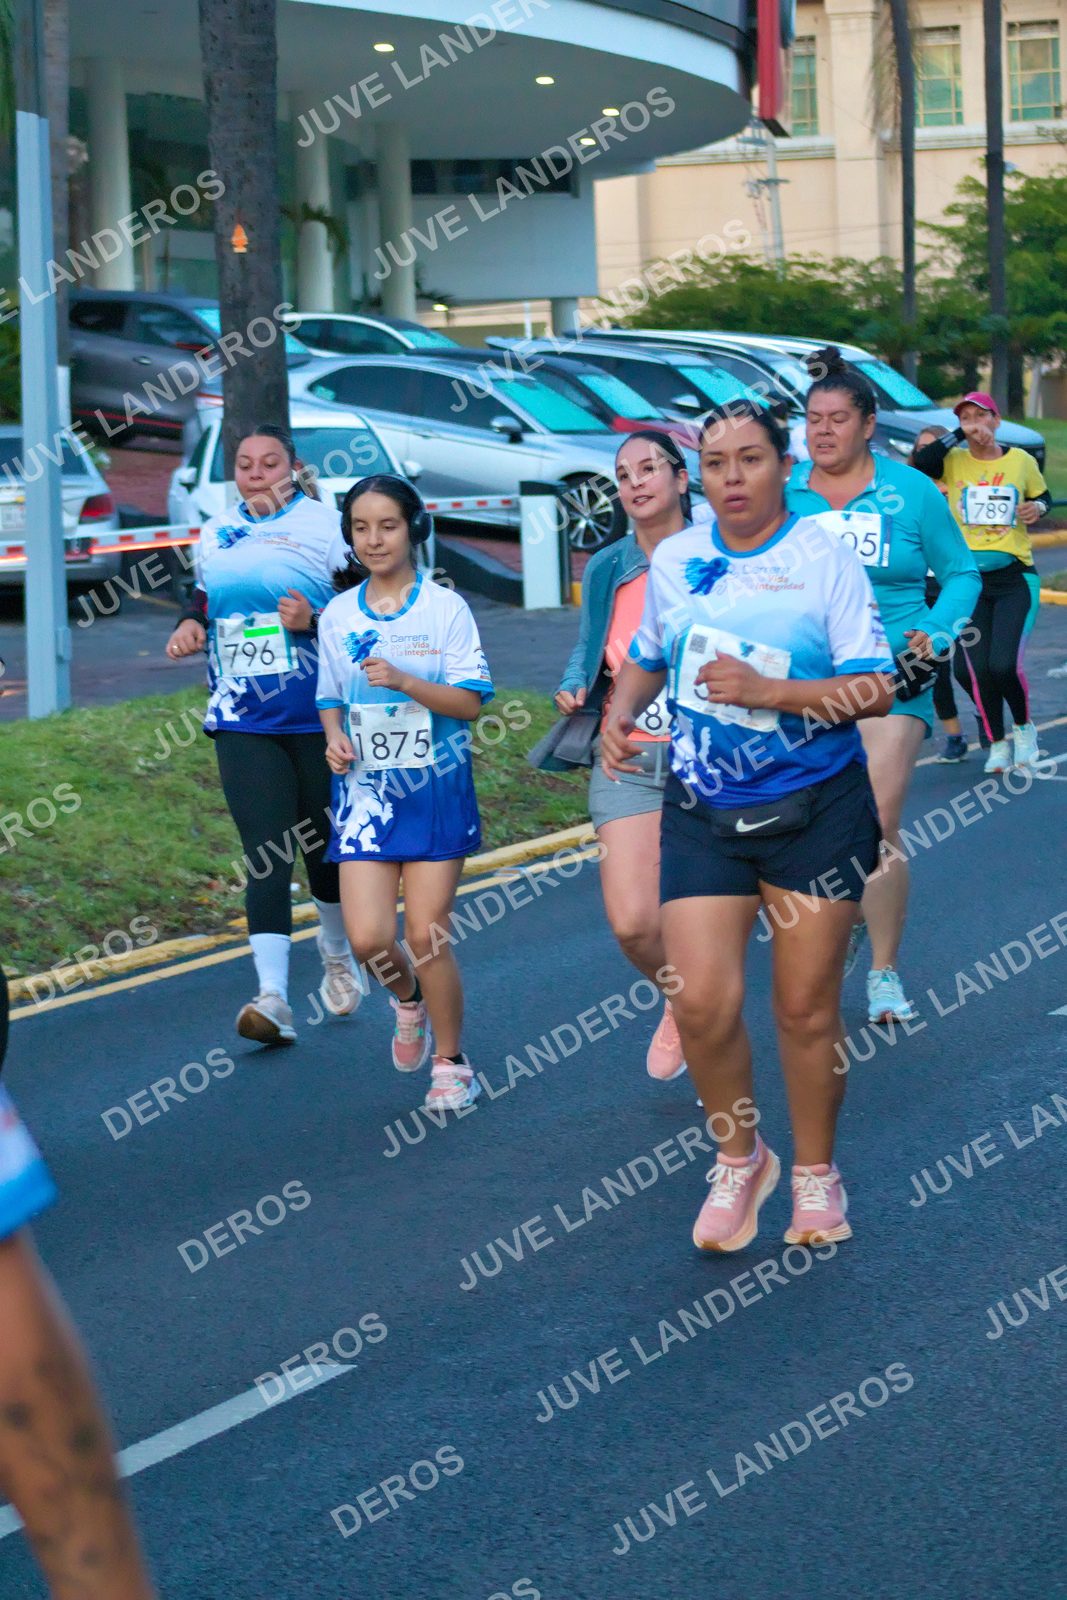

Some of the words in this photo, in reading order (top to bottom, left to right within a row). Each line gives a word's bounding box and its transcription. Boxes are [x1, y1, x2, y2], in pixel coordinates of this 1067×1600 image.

[974, 503, 1008, 519] 789
[390, 634, 429, 643] Carrera
[224, 640, 275, 668] 796
[645, 701, 672, 730] 8
[355, 729, 430, 761] 1875
